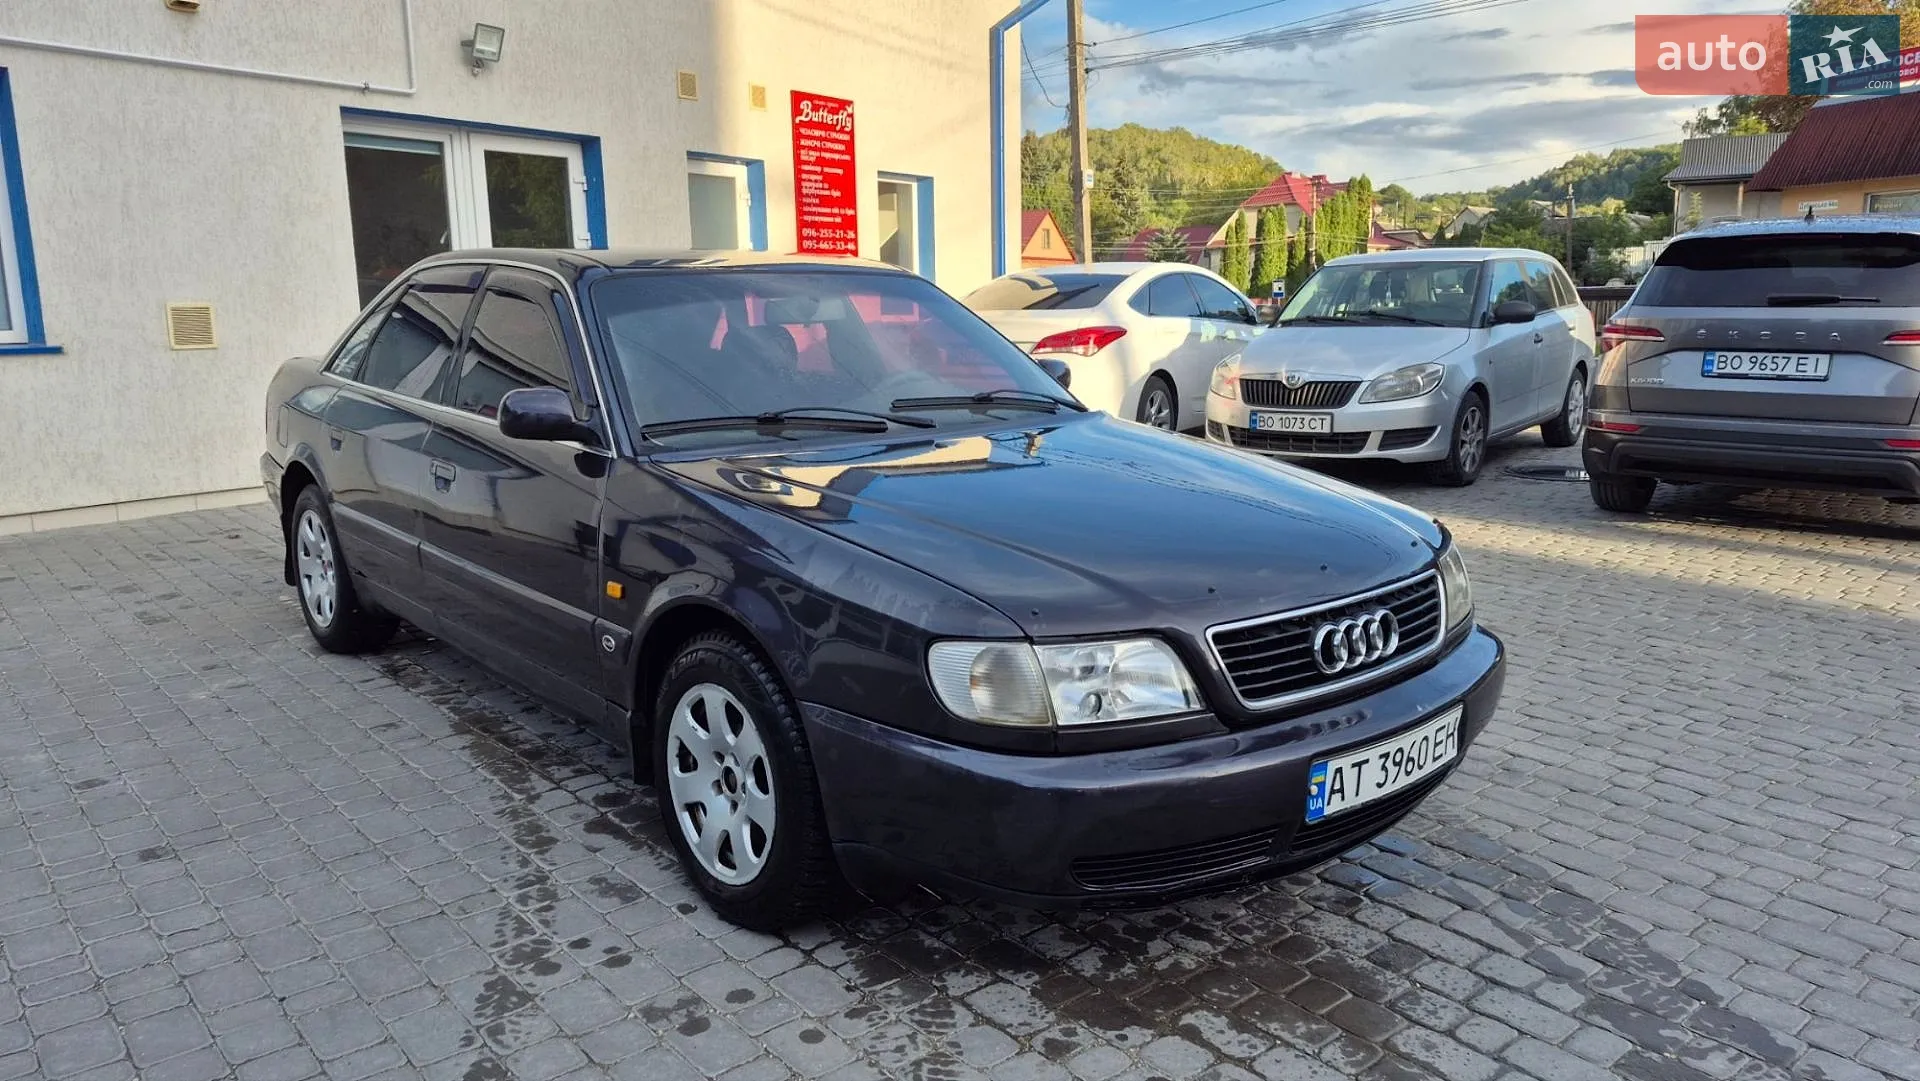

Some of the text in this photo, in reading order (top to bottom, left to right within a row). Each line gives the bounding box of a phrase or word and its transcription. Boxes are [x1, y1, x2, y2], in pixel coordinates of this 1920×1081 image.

[795, 100, 852, 131] Butterfly
[1716, 355, 1820, 373] BO 9657 EI
[1258, 416, 1328, 431] BO 1073 CT
[1326, 716, 1459, 807] AT 3960 EH
[1309, 797, 1323, 810] UA
